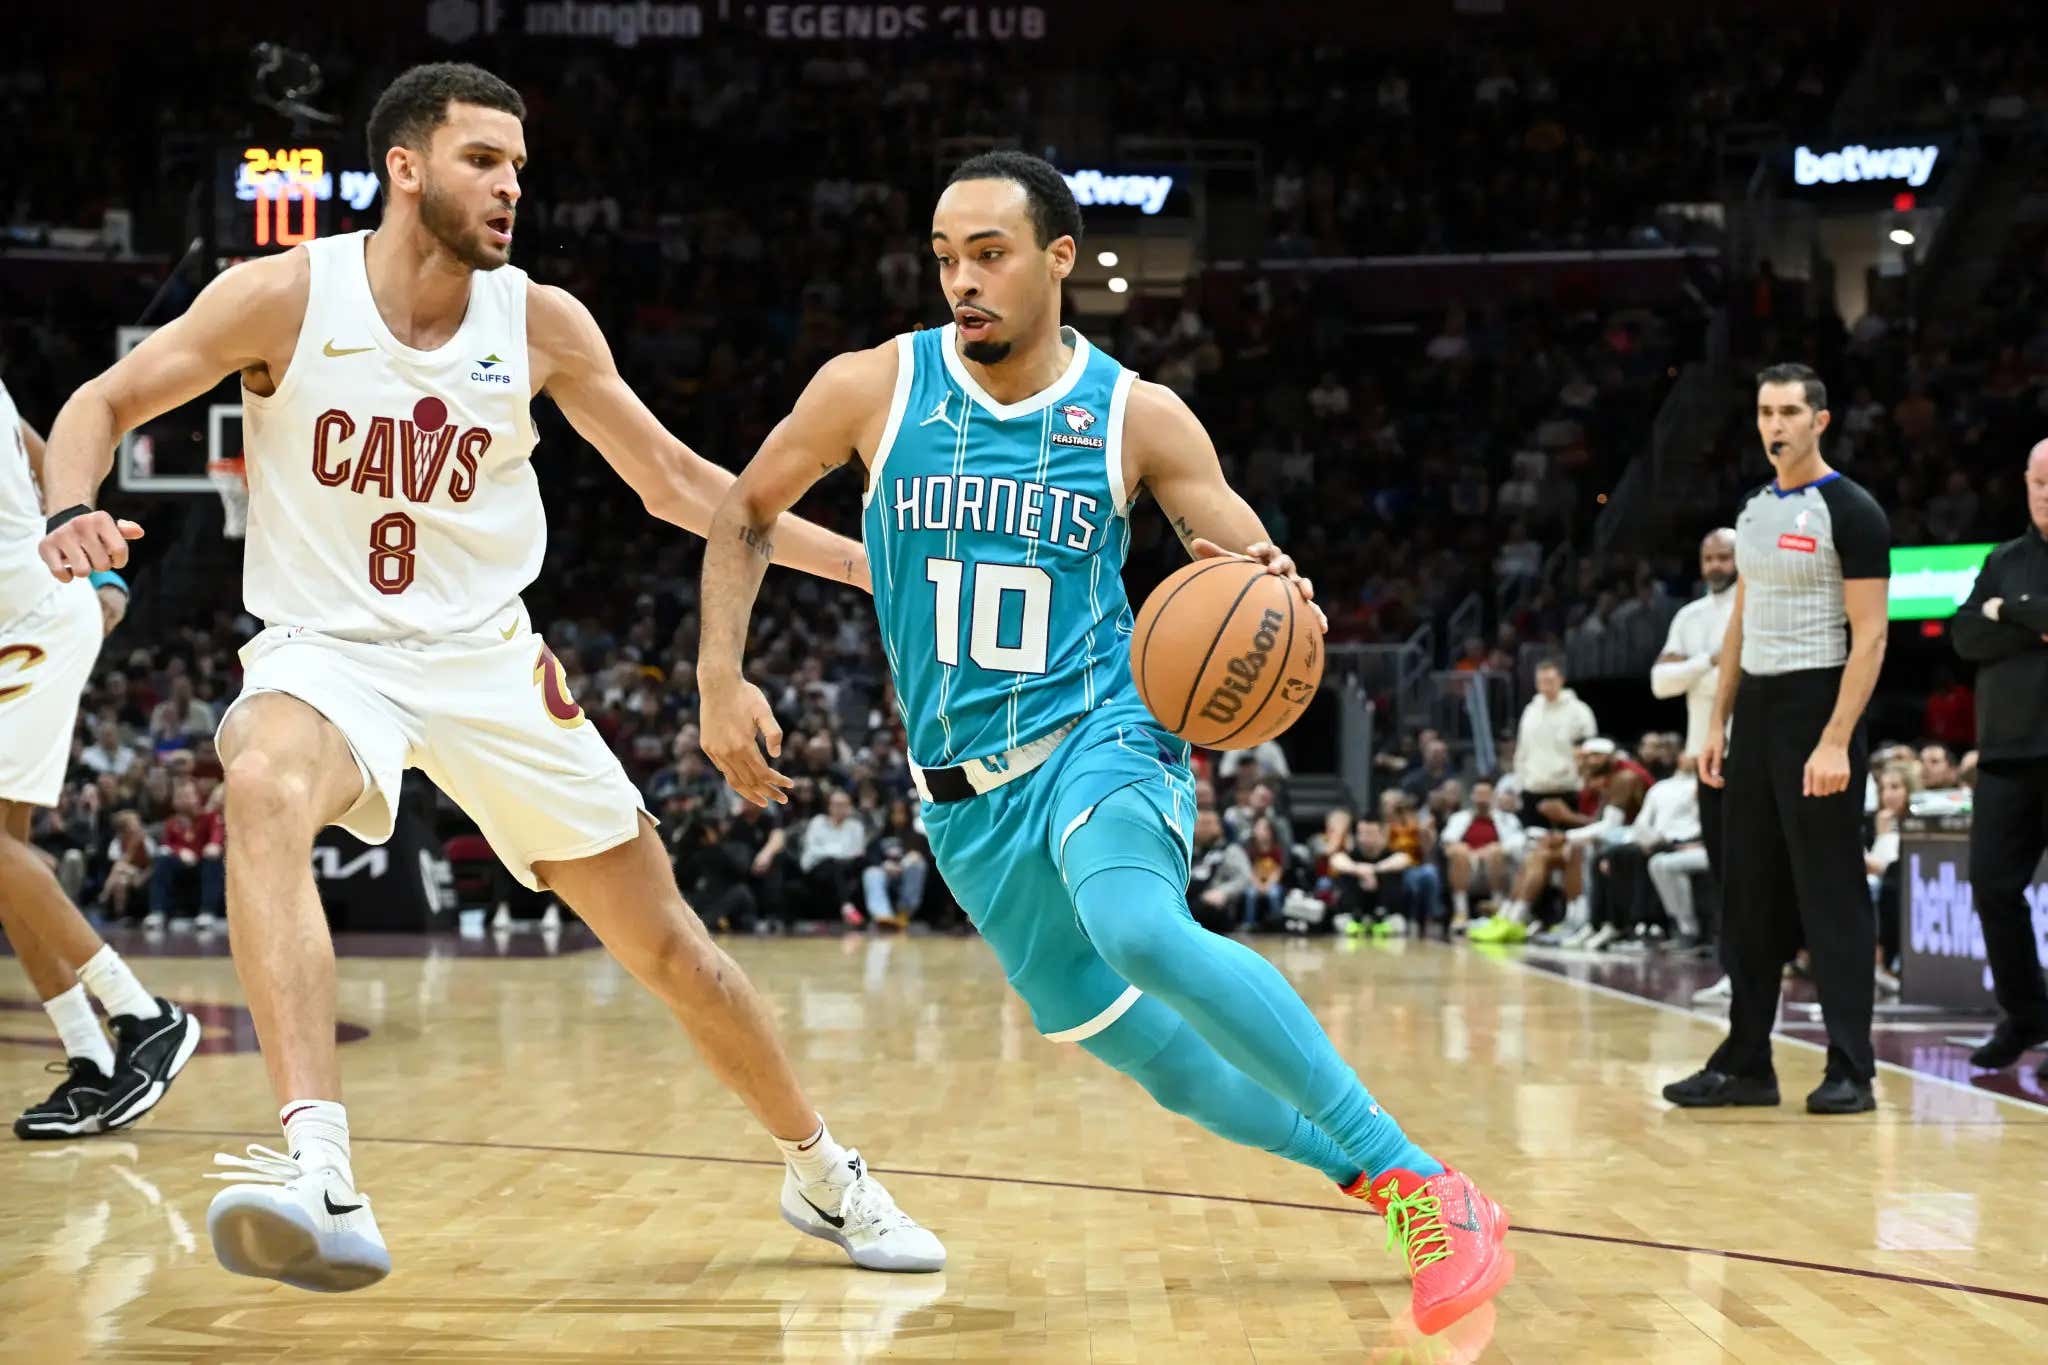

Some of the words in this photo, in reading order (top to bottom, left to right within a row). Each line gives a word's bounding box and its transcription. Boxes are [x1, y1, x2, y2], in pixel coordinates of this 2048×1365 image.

[244, 148, 323, 184] 2:43
[1795, 145, 1938, 187] betway
[256, 184, 317, 246] 10
[471, 372, 511, 384] CLIFFS
[312, 408, 493, 503] CAVS
[1052, 434, 1103, 447] FEASTABLES
[893, 474, 1098, 552] HORNETS
[369, 511, 416, 595] 8
[925, 557, 1053, 675] 10
[1200, 608, 1283, 724] Wilson
